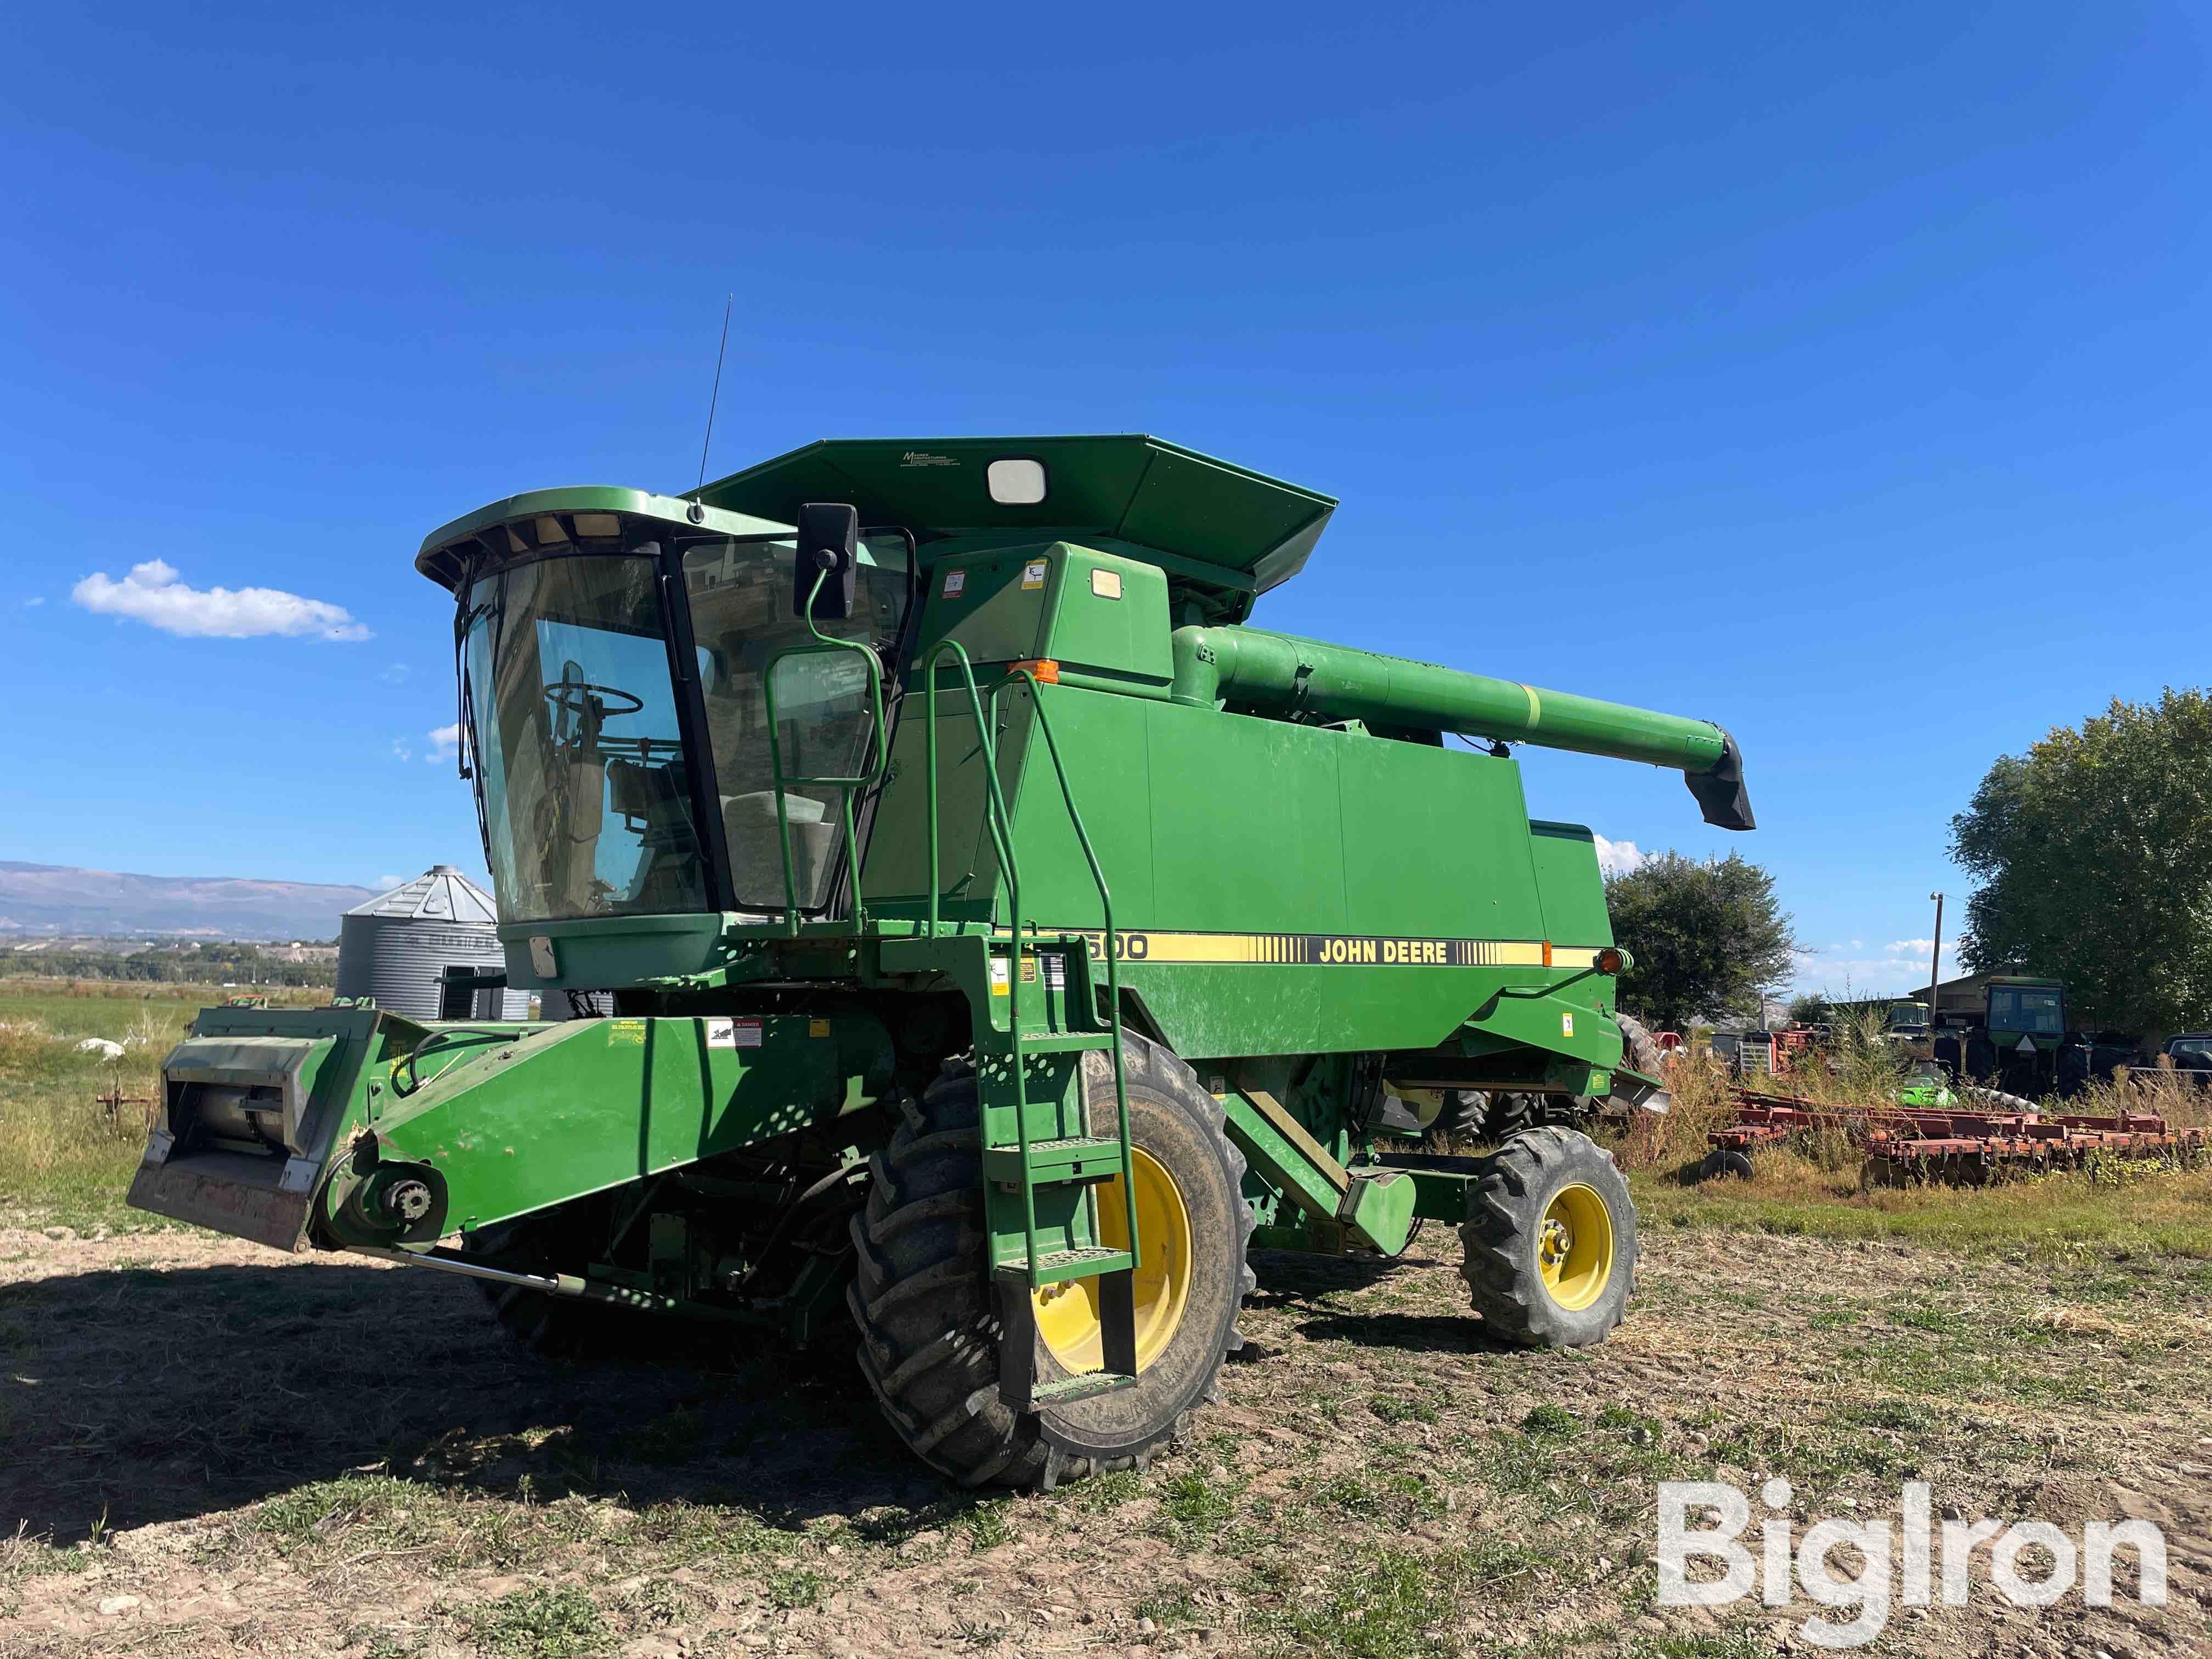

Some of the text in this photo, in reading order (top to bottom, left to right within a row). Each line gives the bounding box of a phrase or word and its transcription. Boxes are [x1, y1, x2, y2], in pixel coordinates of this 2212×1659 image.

[1058, 933, 1148, 959] 500
[1319, 939, 1447, 963] JOHN DEERE
